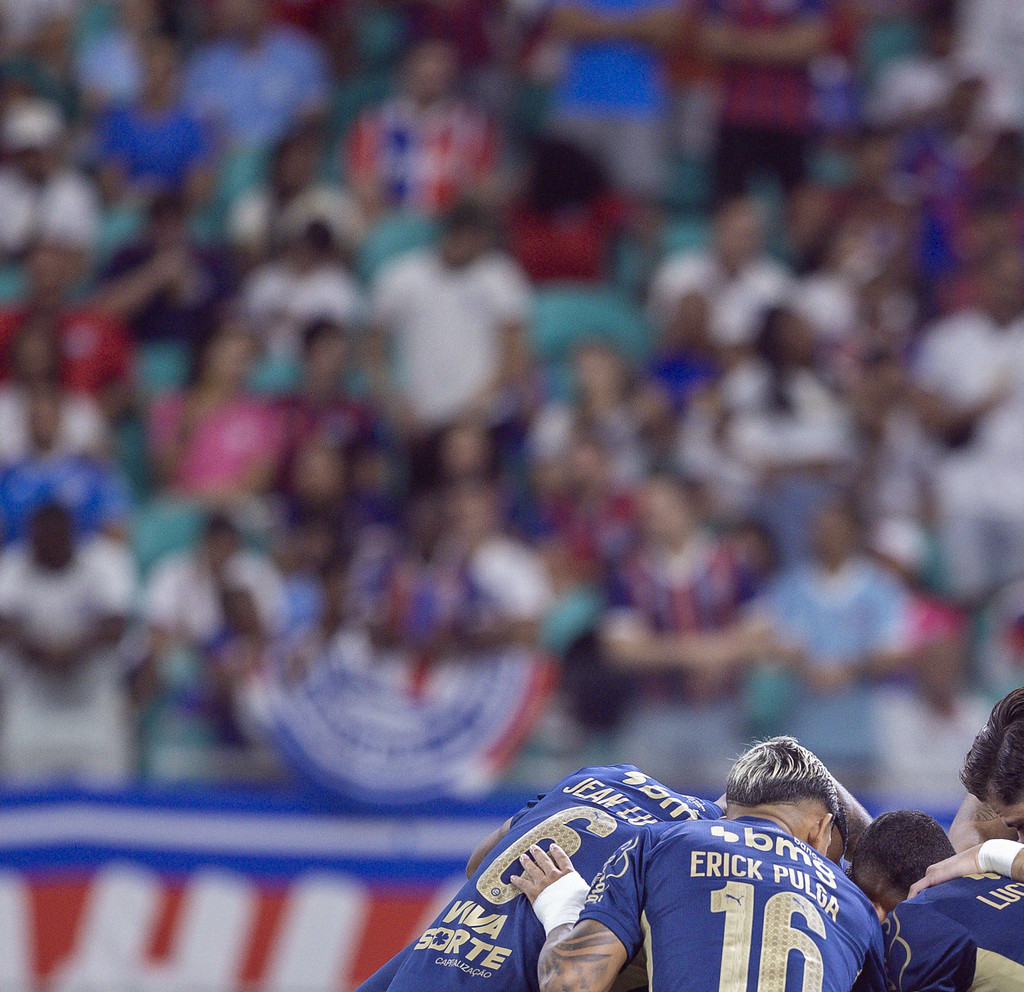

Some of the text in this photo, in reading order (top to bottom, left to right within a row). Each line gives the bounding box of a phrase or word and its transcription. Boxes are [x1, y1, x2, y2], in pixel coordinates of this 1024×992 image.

[562, 777, 630, 809] JEAN
[475, 806, 618, 905] 6
[743, 827, 838, 890] bmg
[690, 850, 840, 923] ERICK PULGA
[442, 900, 509, 940] VIVA
[413, 927, 513, 970] SORTE
[434, 956, 493, 980] CAPITALIZAÇÃO
